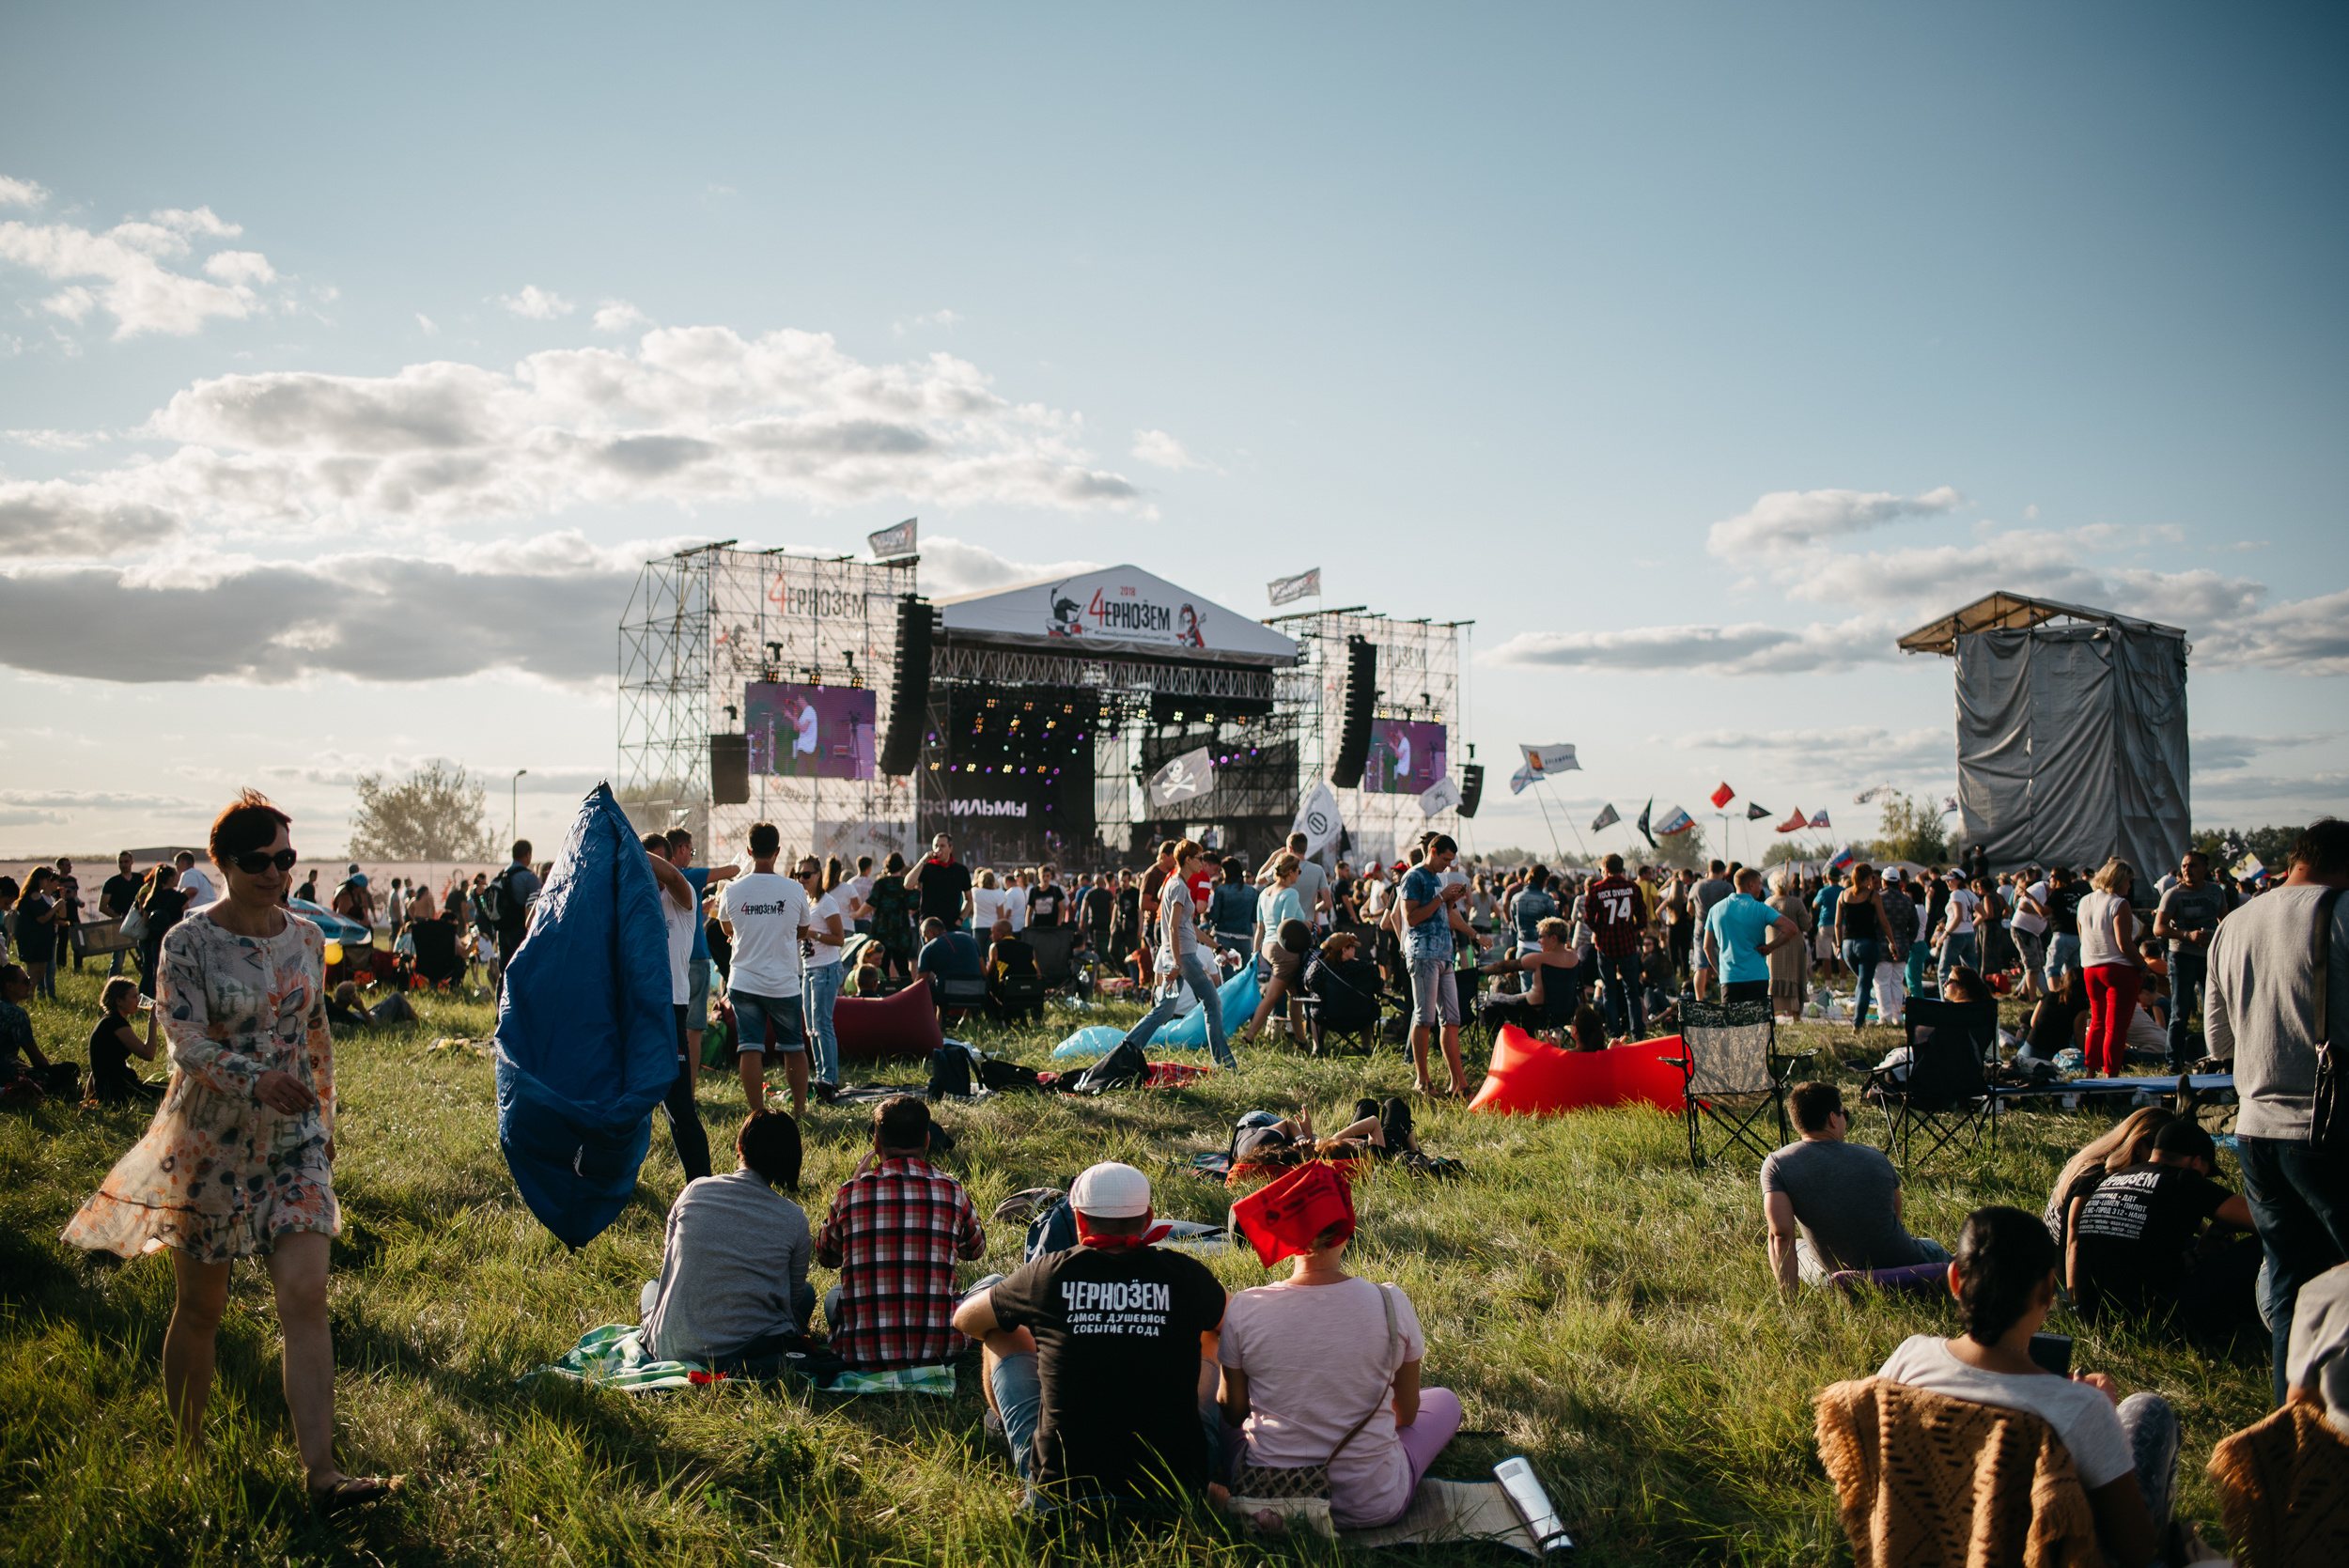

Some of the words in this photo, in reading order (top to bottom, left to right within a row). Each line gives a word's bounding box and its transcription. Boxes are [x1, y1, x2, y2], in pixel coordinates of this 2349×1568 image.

[1120, 586, 1136, 597] 2018
[1597, 890, 1611, 900] ROCK
[1612, 887, 1633, 897] DIVISION
[1603, 896, 1631, 925] 74
[2122, 1193, 2138, 1203] ДДТ
[2123, 1202, 2148, 1213] ПИЛОТ
[2111, 1208, 2125, 1217] 312
[2128, 1211, 2148, 1221] НАИВ
[1066, 1312, 1102, 1324] САМОЕ
[1106, 1313, 1167, 1325] ДУШЕВНОЕ
[1073, 1324, 1125, 1335] СОБЫТИЕ
[1128, 1325, 1159, 1337] ГОДА
